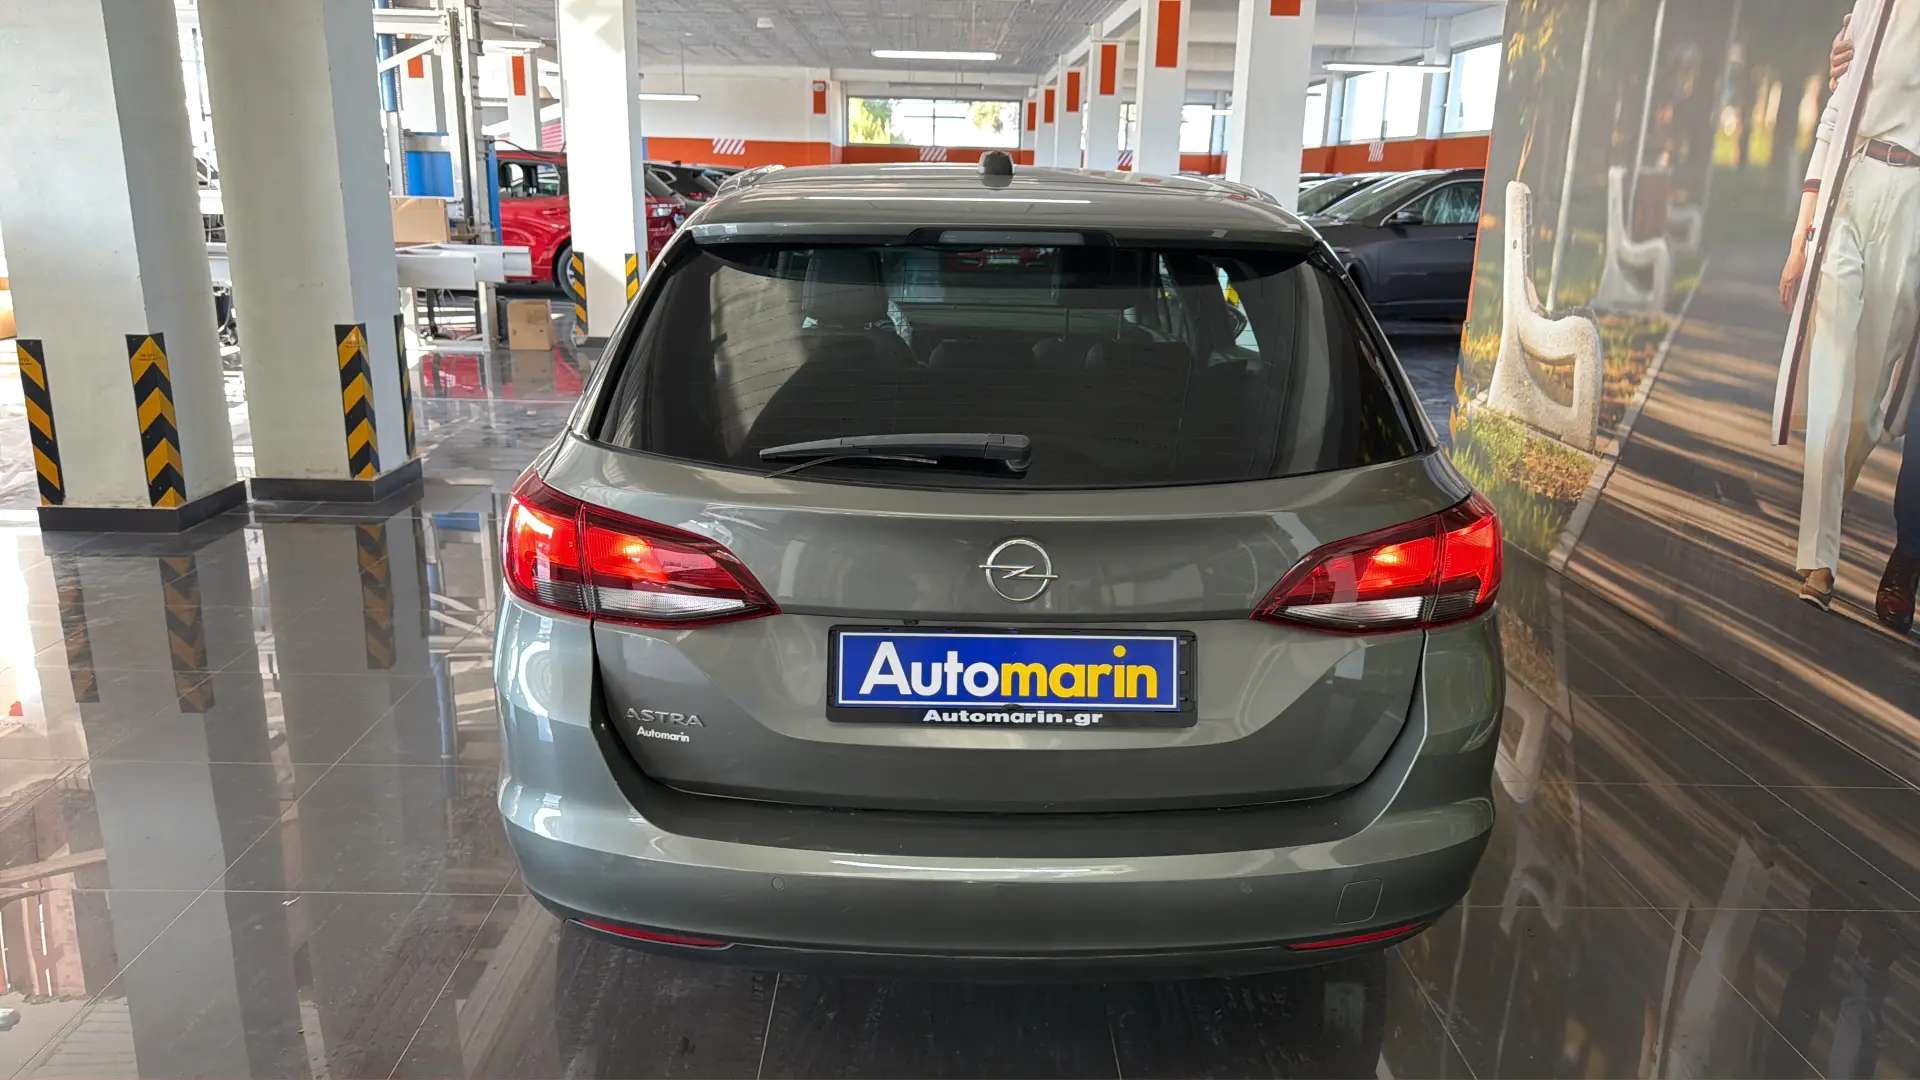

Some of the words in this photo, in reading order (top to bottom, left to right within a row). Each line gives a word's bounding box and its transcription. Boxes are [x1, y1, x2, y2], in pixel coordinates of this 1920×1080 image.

[858, 641, 1158, 699] Automarin
[625, 707, 706, 728] ASTRA
[922, 709, 1104, 727] Automarin.gr
[636, 725, 691, 743] Automarin
